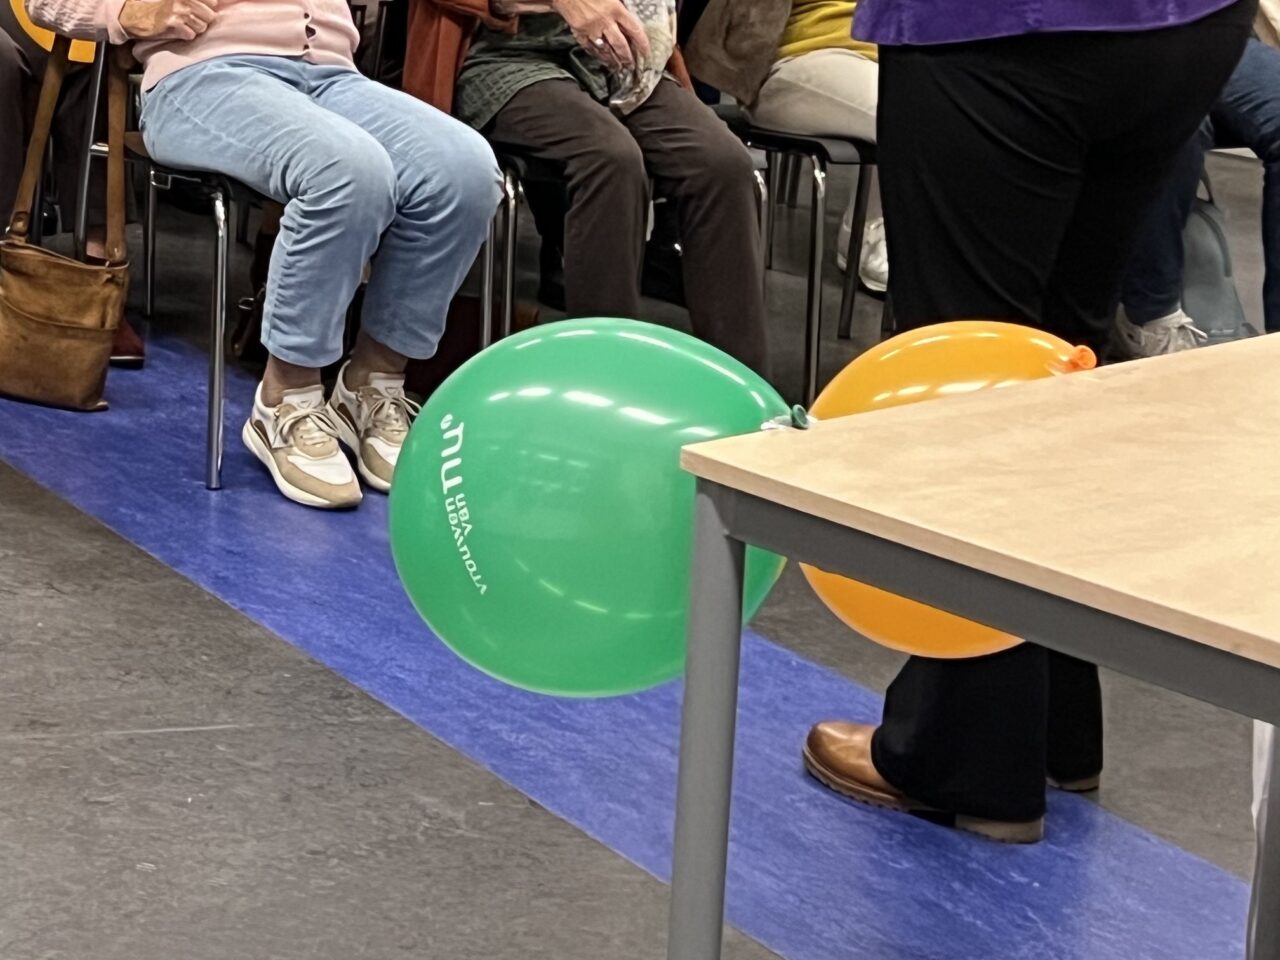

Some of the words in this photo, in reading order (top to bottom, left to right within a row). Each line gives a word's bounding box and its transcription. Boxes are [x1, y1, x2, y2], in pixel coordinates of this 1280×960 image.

[440, 421, 464, 495] nu
[444, 496, 488, 595] vrouwen
[455, 493, 472, 536] van
